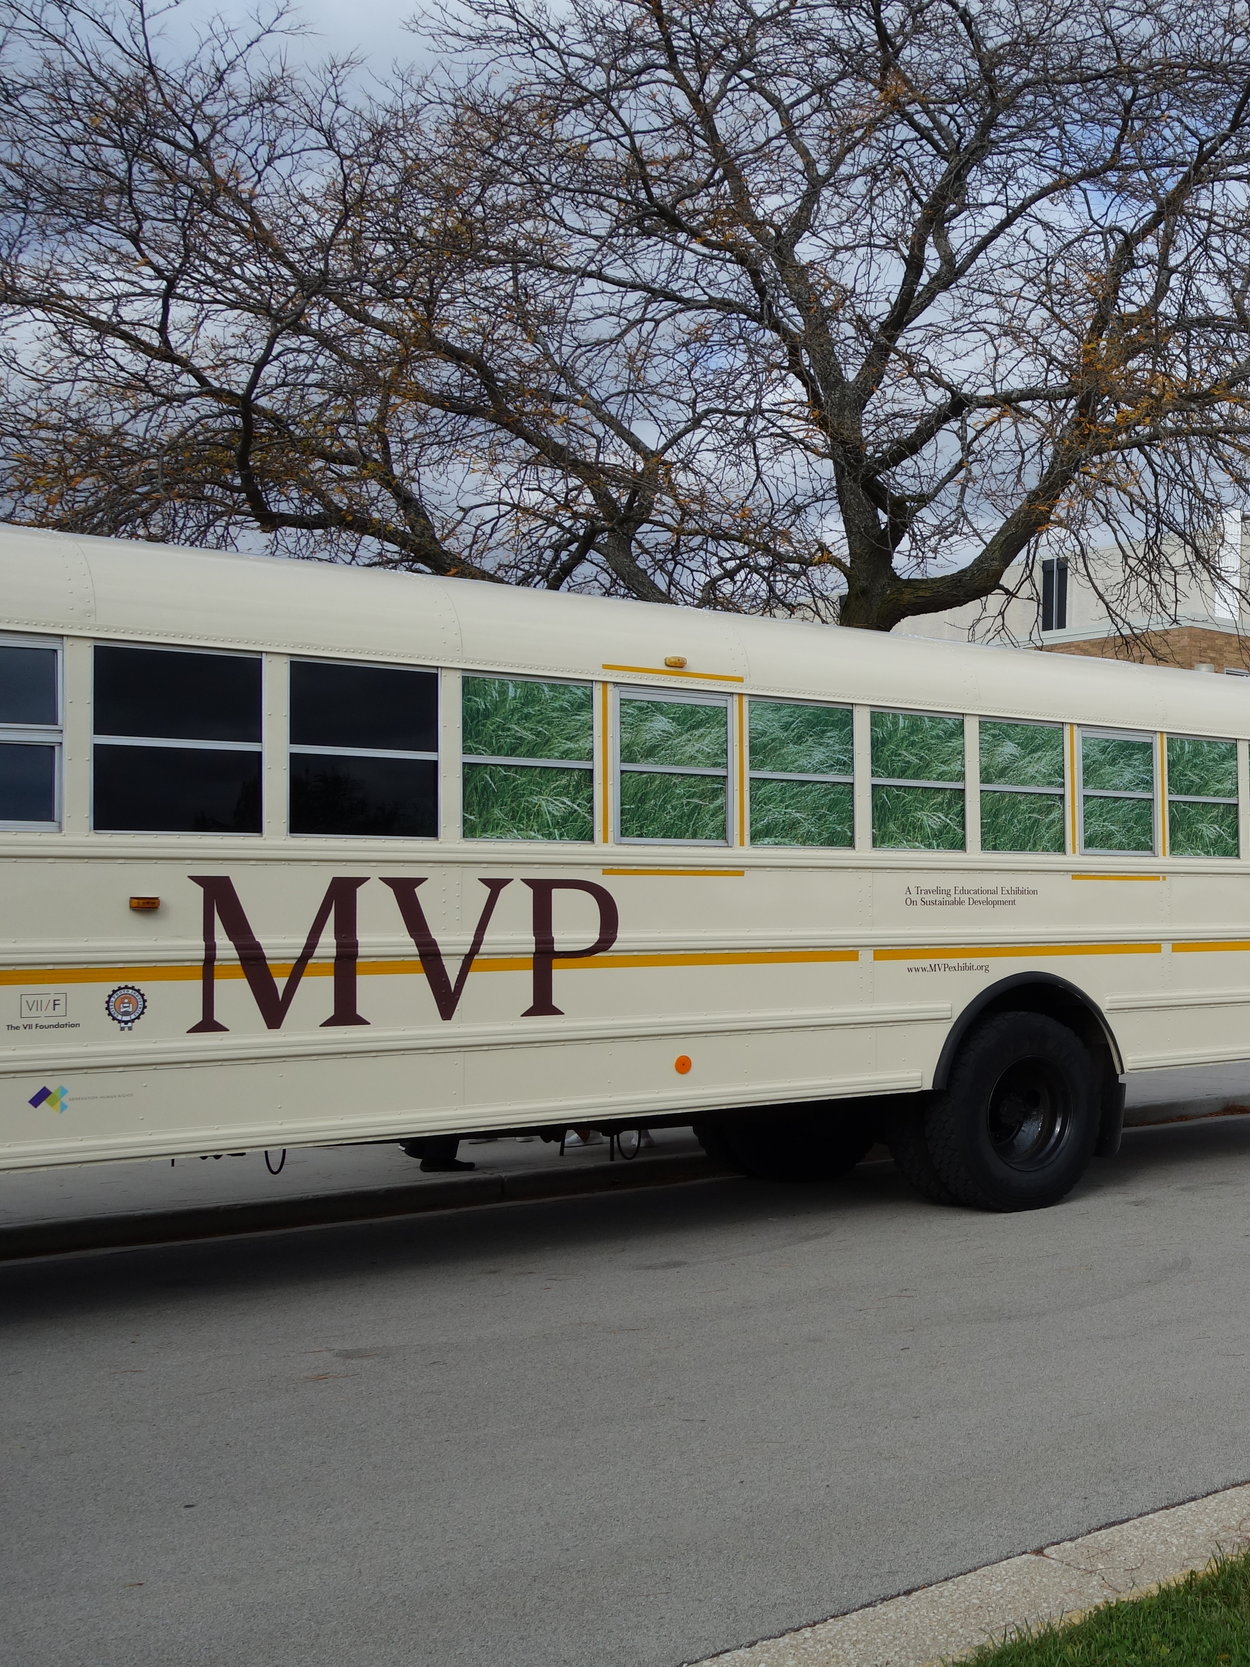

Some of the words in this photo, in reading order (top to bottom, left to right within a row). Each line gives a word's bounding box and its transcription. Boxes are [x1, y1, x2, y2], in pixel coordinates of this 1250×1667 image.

[905, 886, 912, 895] A
[914, 886, 951, 897] Traveling
[954, 886, 998, 895] Educational
[1001, 887, 1038, 896] Exhibition
[905, 897, 918, 906] On
[920, 897, 966, 906] Sustainable
[968, 897, 1016, 908] Development
[187, 875, 618, 1033] MVP
[907, 963, 990, 973] www.MVPexhibit.org
[35, 1021, 81, 1030] Foundation
